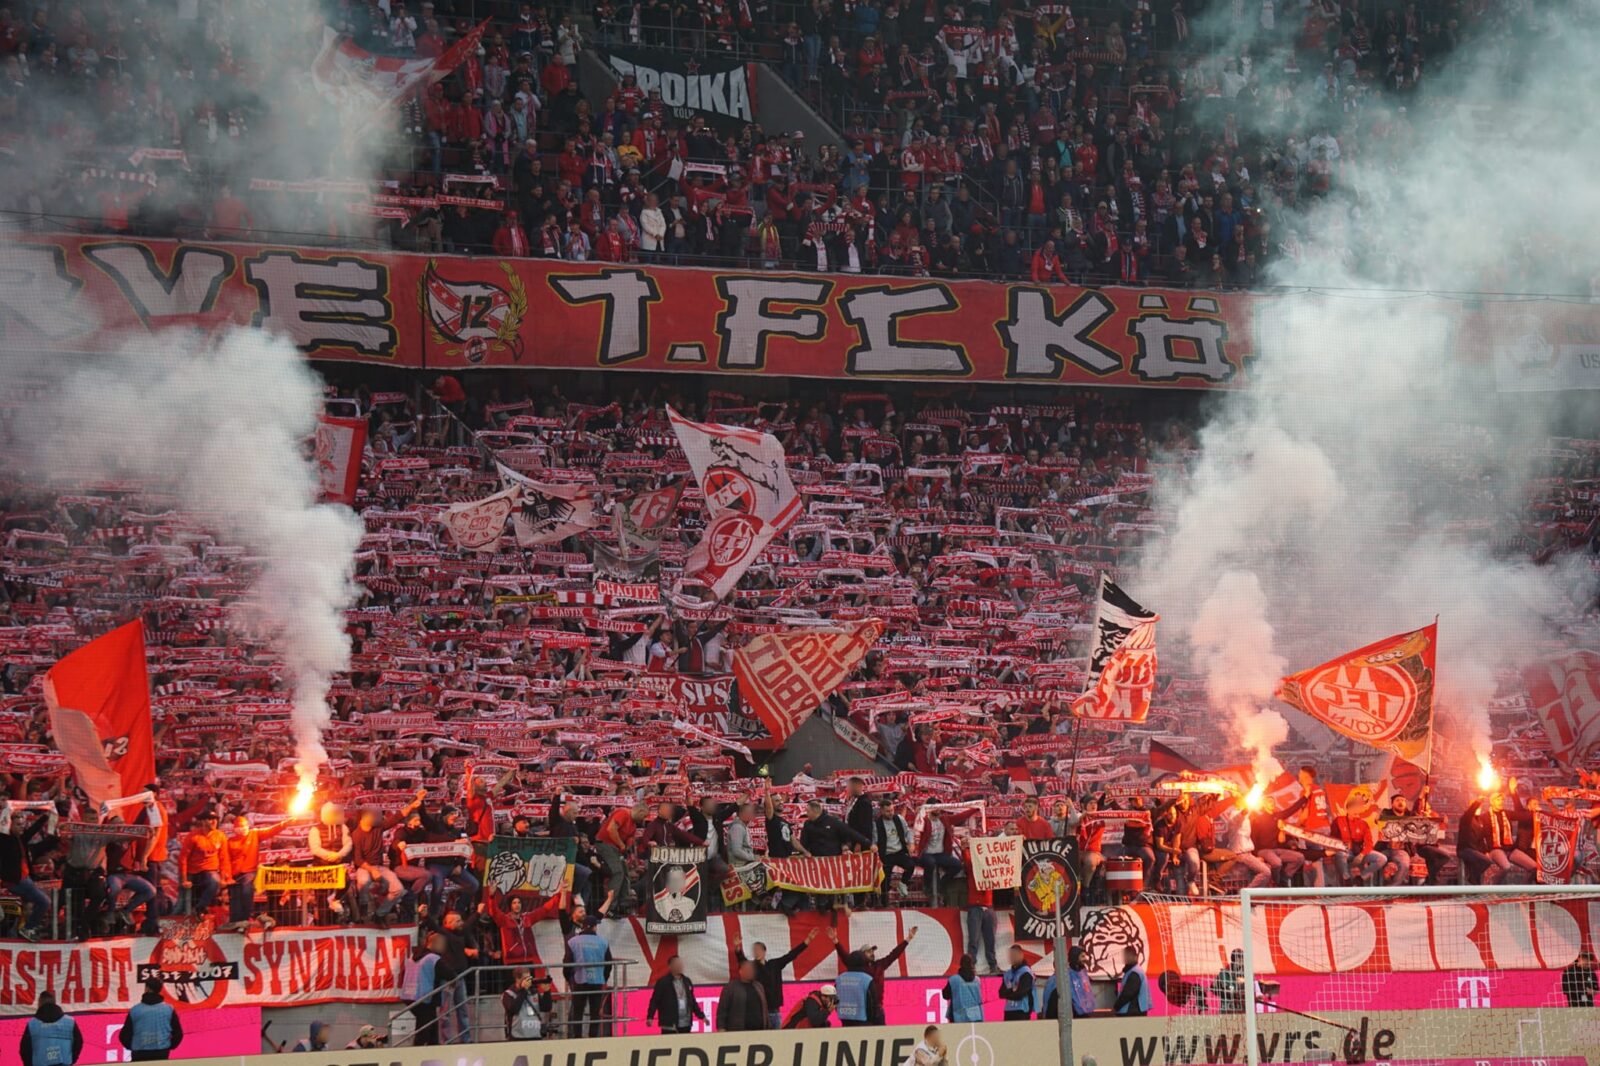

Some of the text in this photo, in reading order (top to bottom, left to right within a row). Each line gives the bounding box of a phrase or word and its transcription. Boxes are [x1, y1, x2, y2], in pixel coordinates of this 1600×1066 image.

[597, 579, 659, 600] CHAOTIX
[547, 608, 586, 618] CHAOTIX
[597, 621, 636, 632] CHAOTIX
[681, 681, 730, 706] SPS
[652, 847, 706, 863] DOMINIK
[976, 843, 984, 855] E
[985, 855, 1010, 867] LANG
[982, 866, 1015, 879] ULTRAS
[1003, 878, 1013, 888] FC
[243, 935, 412, 996] SYNDIKAT
